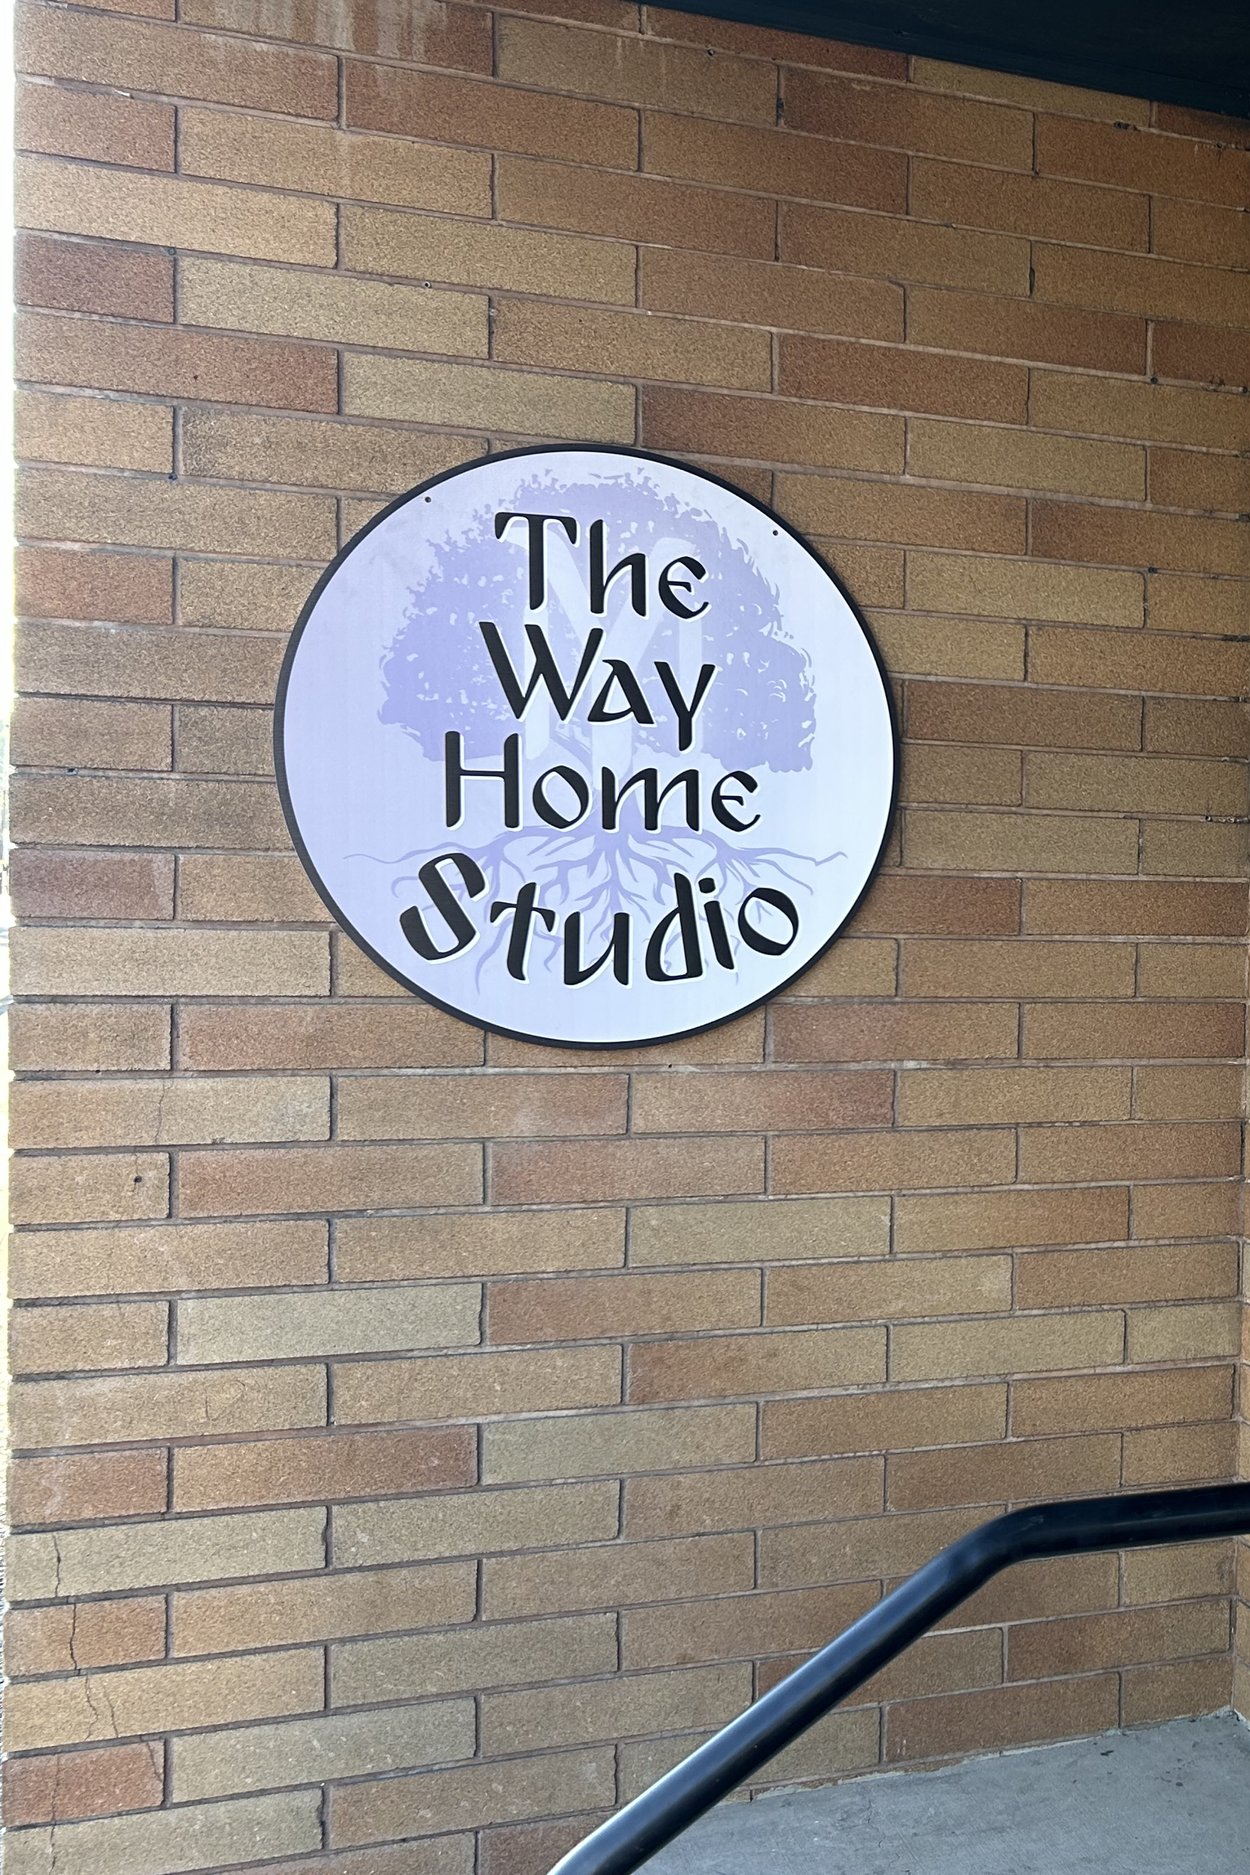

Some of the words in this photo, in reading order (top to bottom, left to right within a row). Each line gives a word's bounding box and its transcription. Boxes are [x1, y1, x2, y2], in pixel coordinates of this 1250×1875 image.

[494, 511, 710, 620] The
[479, 621, 716, 751] Way
[444, 730, 762, 833] Home
[398, 851, 800, 986] Studio
